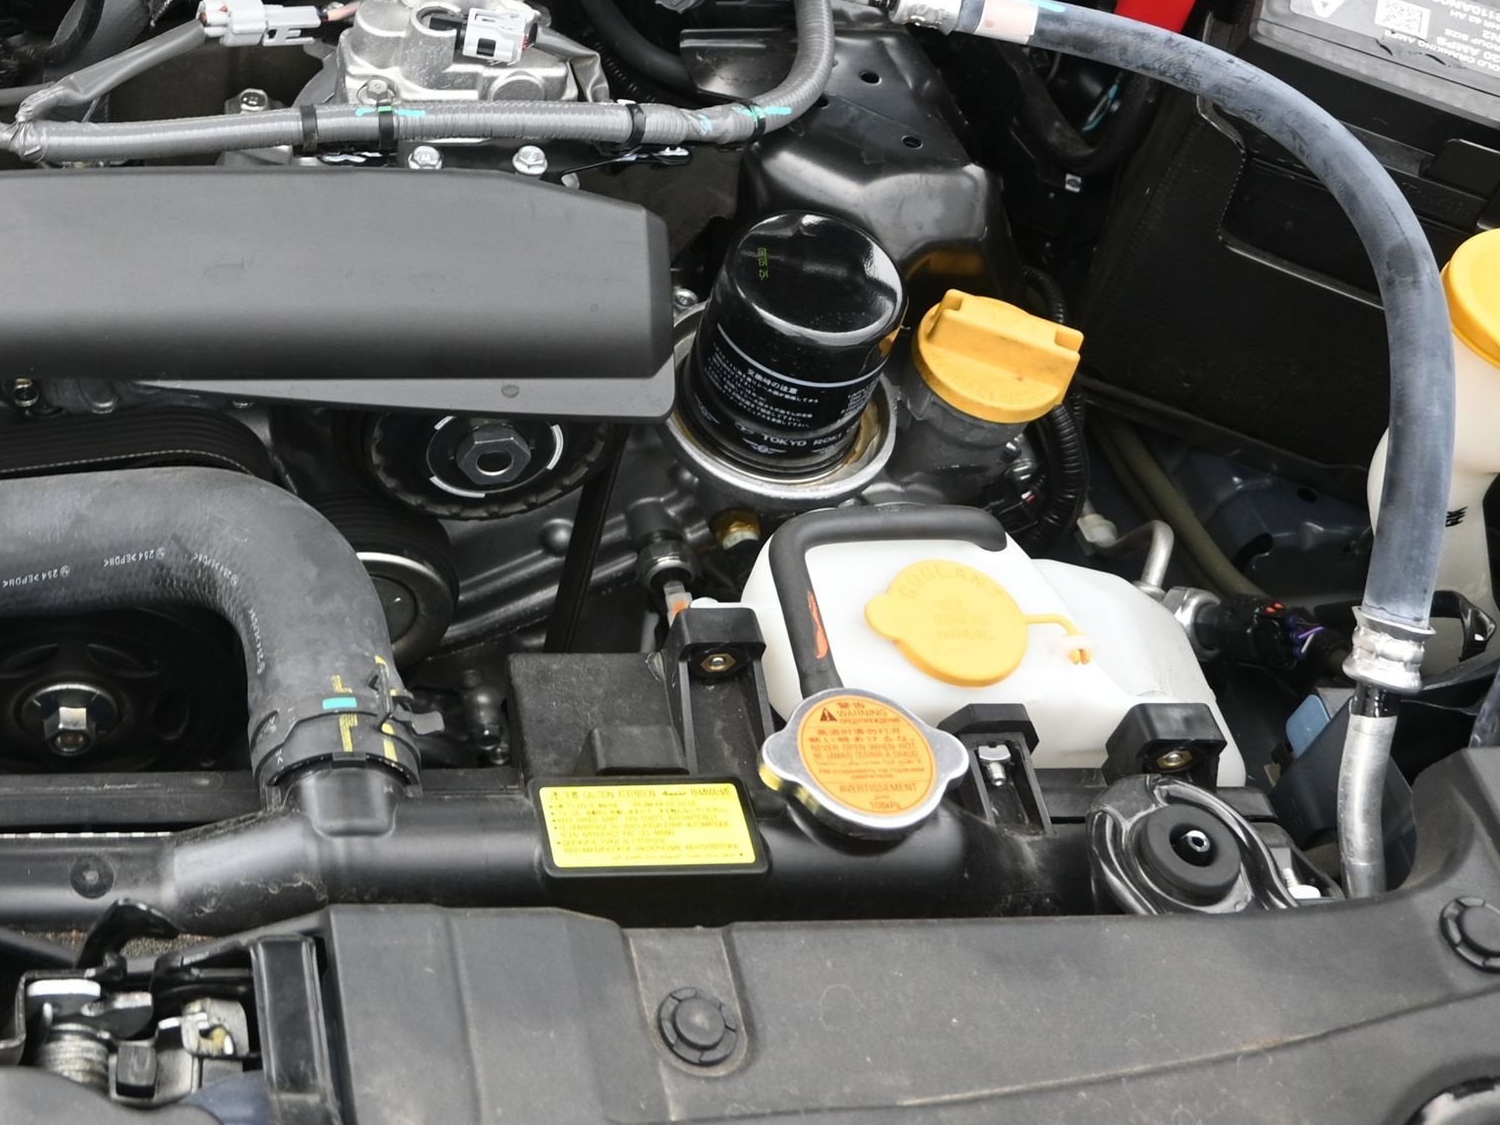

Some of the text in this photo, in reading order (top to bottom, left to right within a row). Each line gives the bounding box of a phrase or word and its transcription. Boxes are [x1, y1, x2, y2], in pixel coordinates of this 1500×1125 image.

[762, 433, 808, 447] TOKYO
[837, 709, 888, 718] WARNING
[839, 782, 917, 793] AVERTISSEMENT
